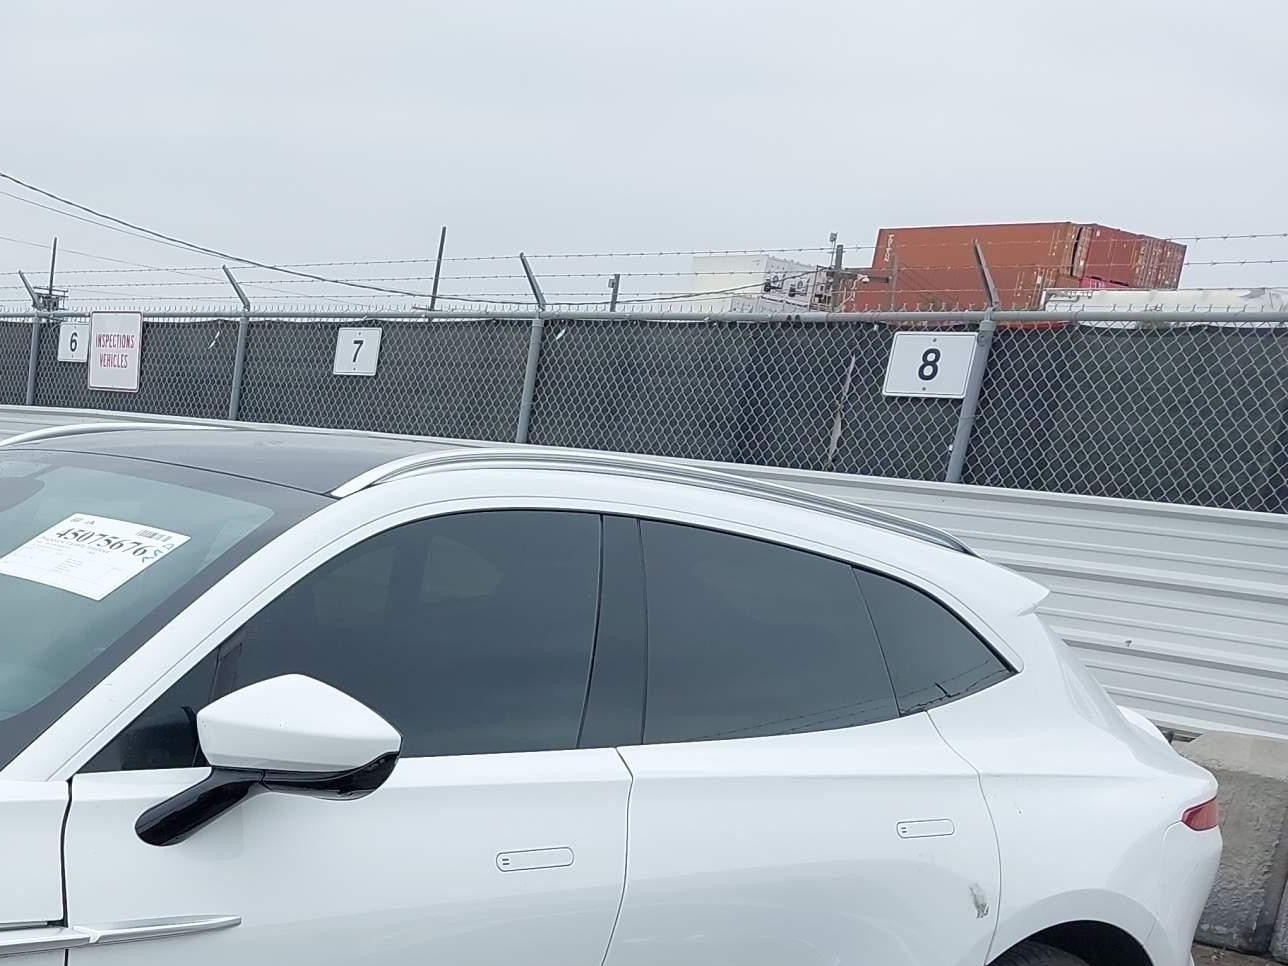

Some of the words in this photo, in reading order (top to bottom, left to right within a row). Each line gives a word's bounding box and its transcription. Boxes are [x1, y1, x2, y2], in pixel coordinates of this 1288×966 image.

[70, 332, 78, 353] 6
[95, 333, 135, 349] INSPECTIONS
[352, 340, 364, 363] 7
[99, 353, 129, 369] VEHICLES
[918, 348, 941, 381] 8
[56, 527, 153, 557] 45075676
